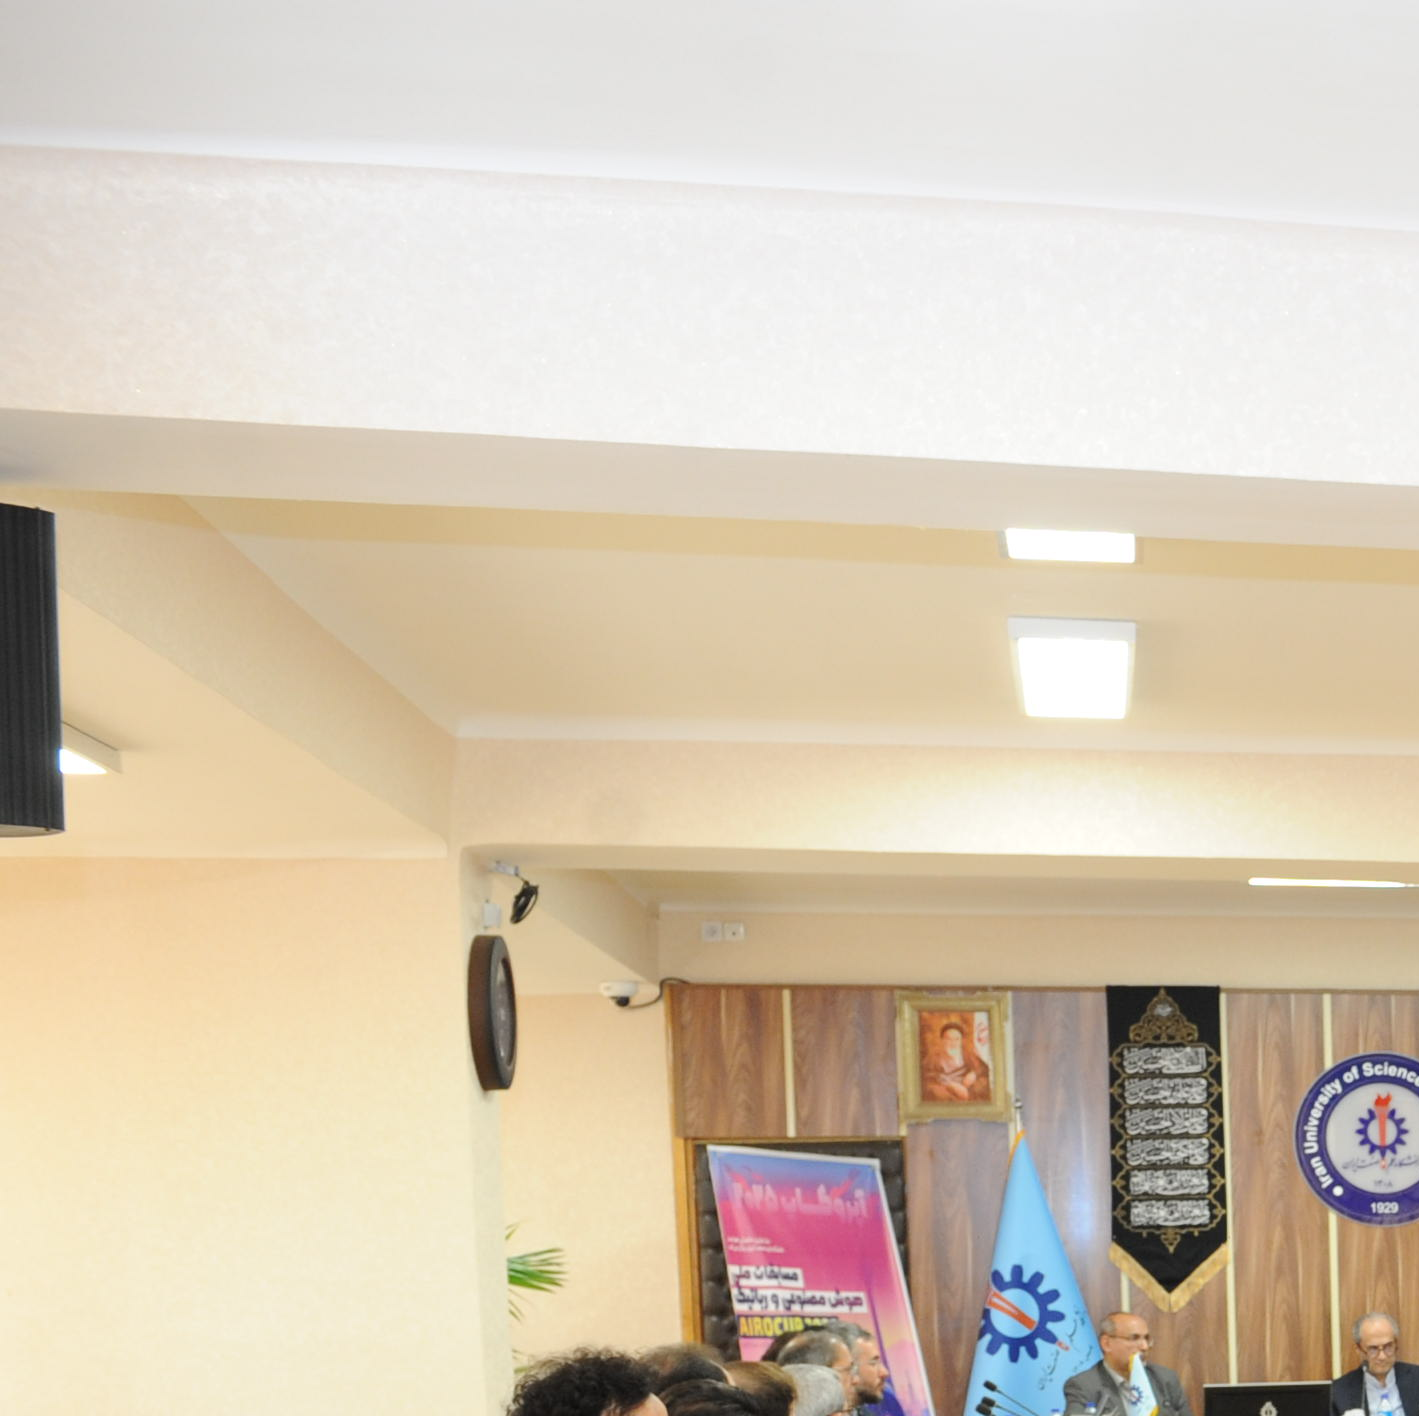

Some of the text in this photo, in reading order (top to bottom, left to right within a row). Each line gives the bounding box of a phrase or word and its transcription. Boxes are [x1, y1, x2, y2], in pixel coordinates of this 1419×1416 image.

[1343, 1065, 1359, 1083] of
[1304, 1079, 1342, 1154] University
[1310, 1157, 1333, 1189] Iran
[1370, 1202, 1399, 1214] 1929
[733, 1262, 799, 1288] مسابقات ملی
[735, 1288, 864, 1311] هوش مصنوعی و رباتیک
